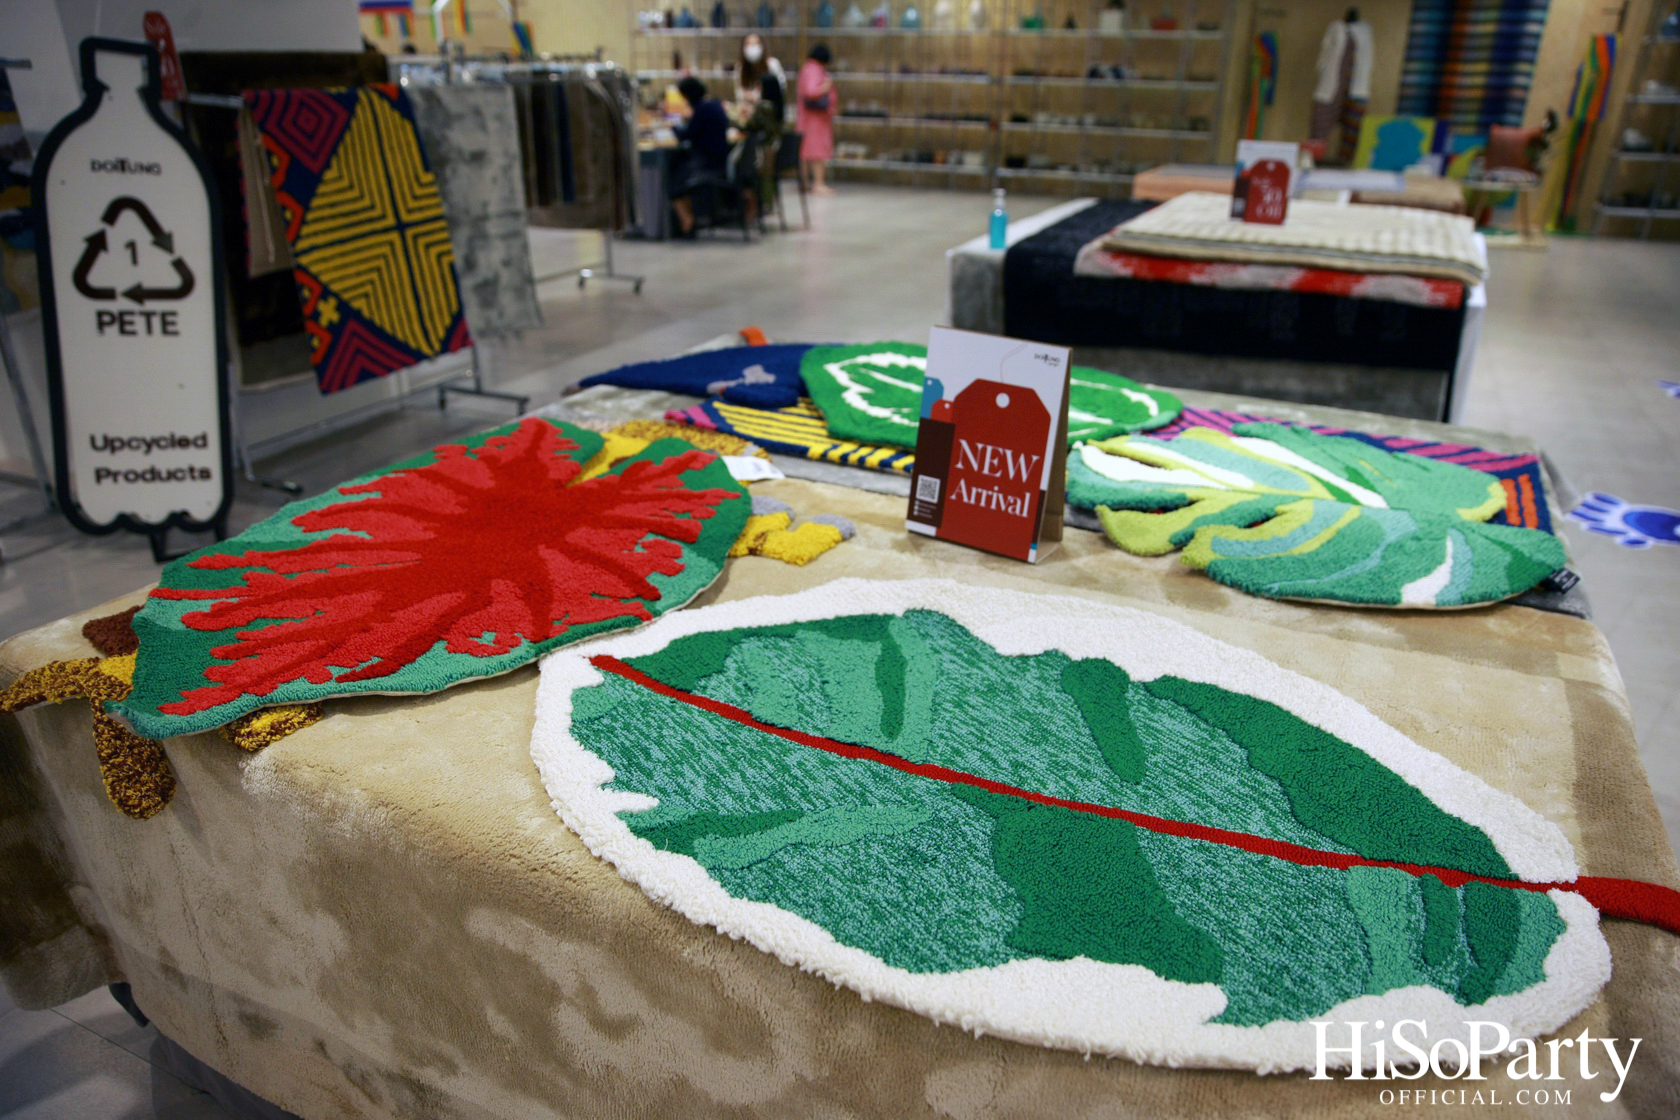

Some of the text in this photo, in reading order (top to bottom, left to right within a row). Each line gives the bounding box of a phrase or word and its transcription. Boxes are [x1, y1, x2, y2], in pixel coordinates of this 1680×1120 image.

[125, 239, 138, 267] 1
[96, 309, 180, 336] PETE
[89, 431, 208, 455] Upcycled
[94, 464, 212, 485] Products
[955, 439, 1041, 483] NEW
[950, 478, 1031, 518] Arrival
